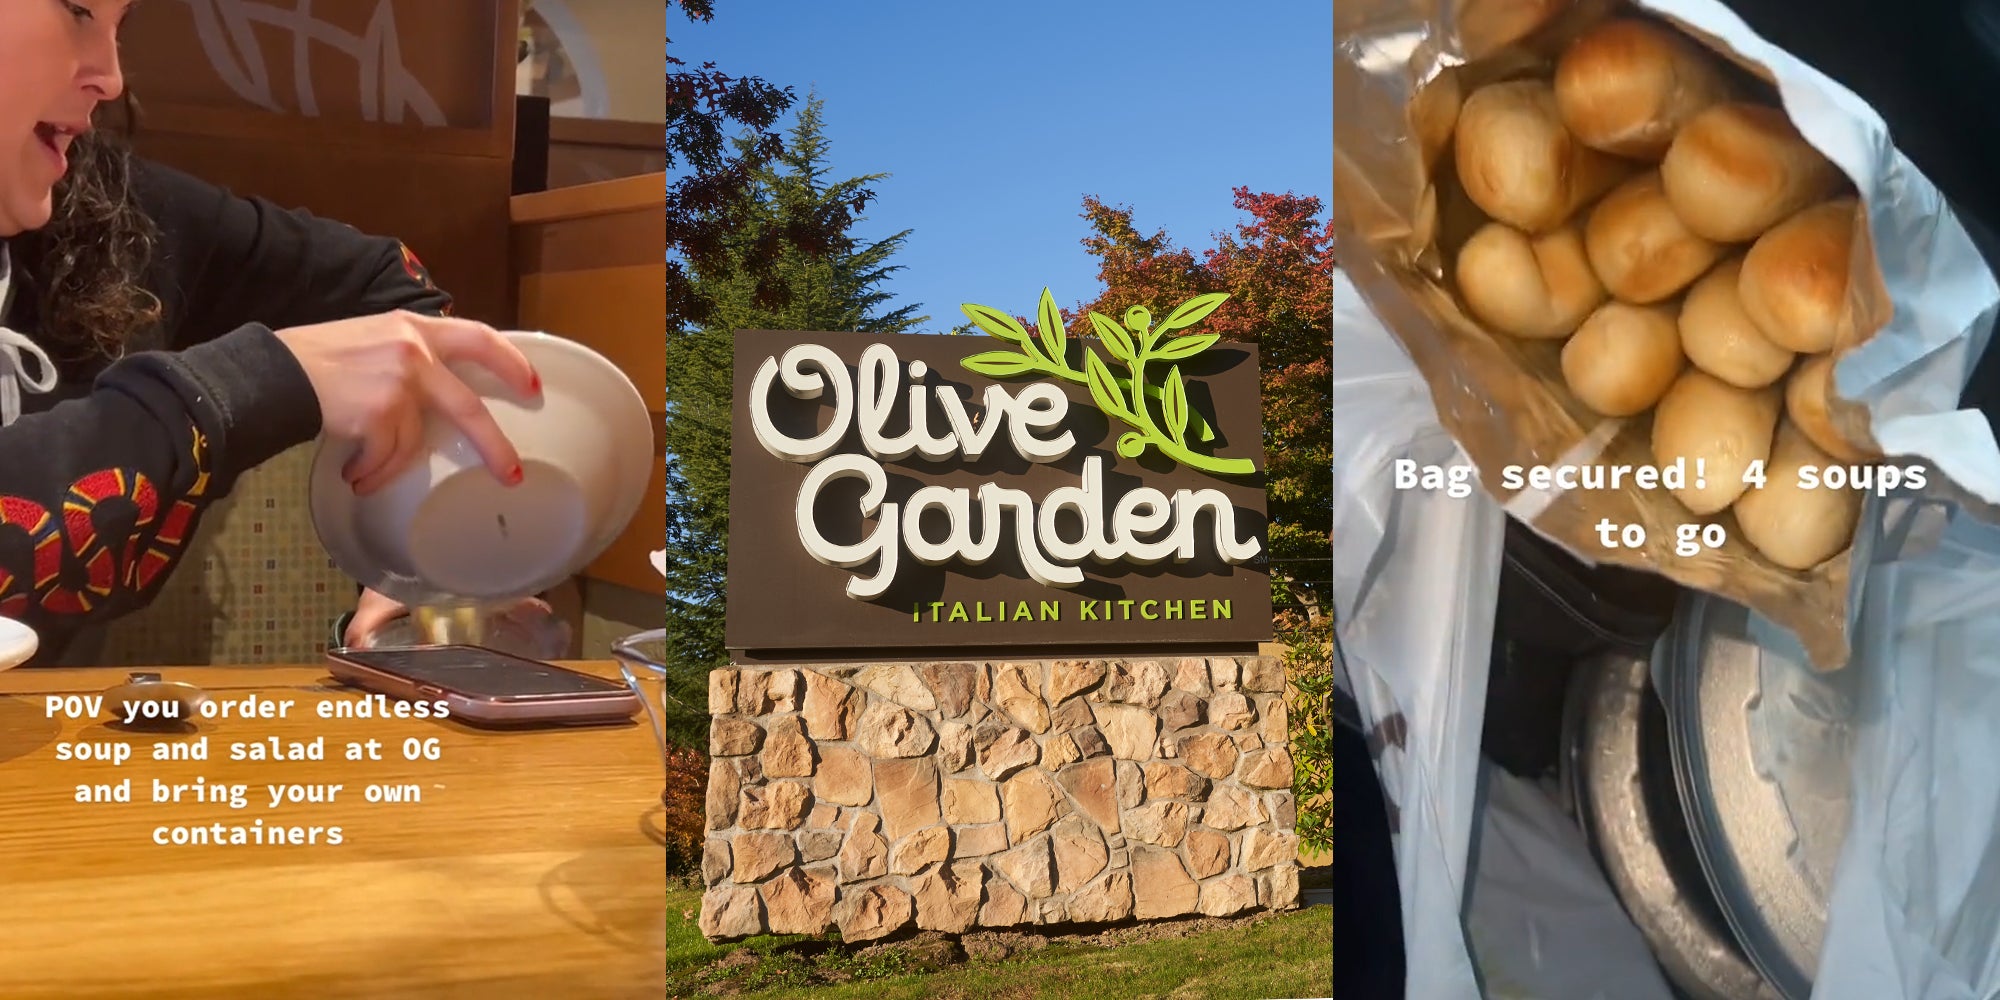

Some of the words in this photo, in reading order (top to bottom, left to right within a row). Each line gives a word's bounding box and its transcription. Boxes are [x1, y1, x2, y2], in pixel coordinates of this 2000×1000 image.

[749, 342, 1076, 464] Olive
[795, 452, 1262, 600] Garden
[913, 600, 1061, 622] ITALIAN
[1079, 599, 1234, 621] KITCHEN
